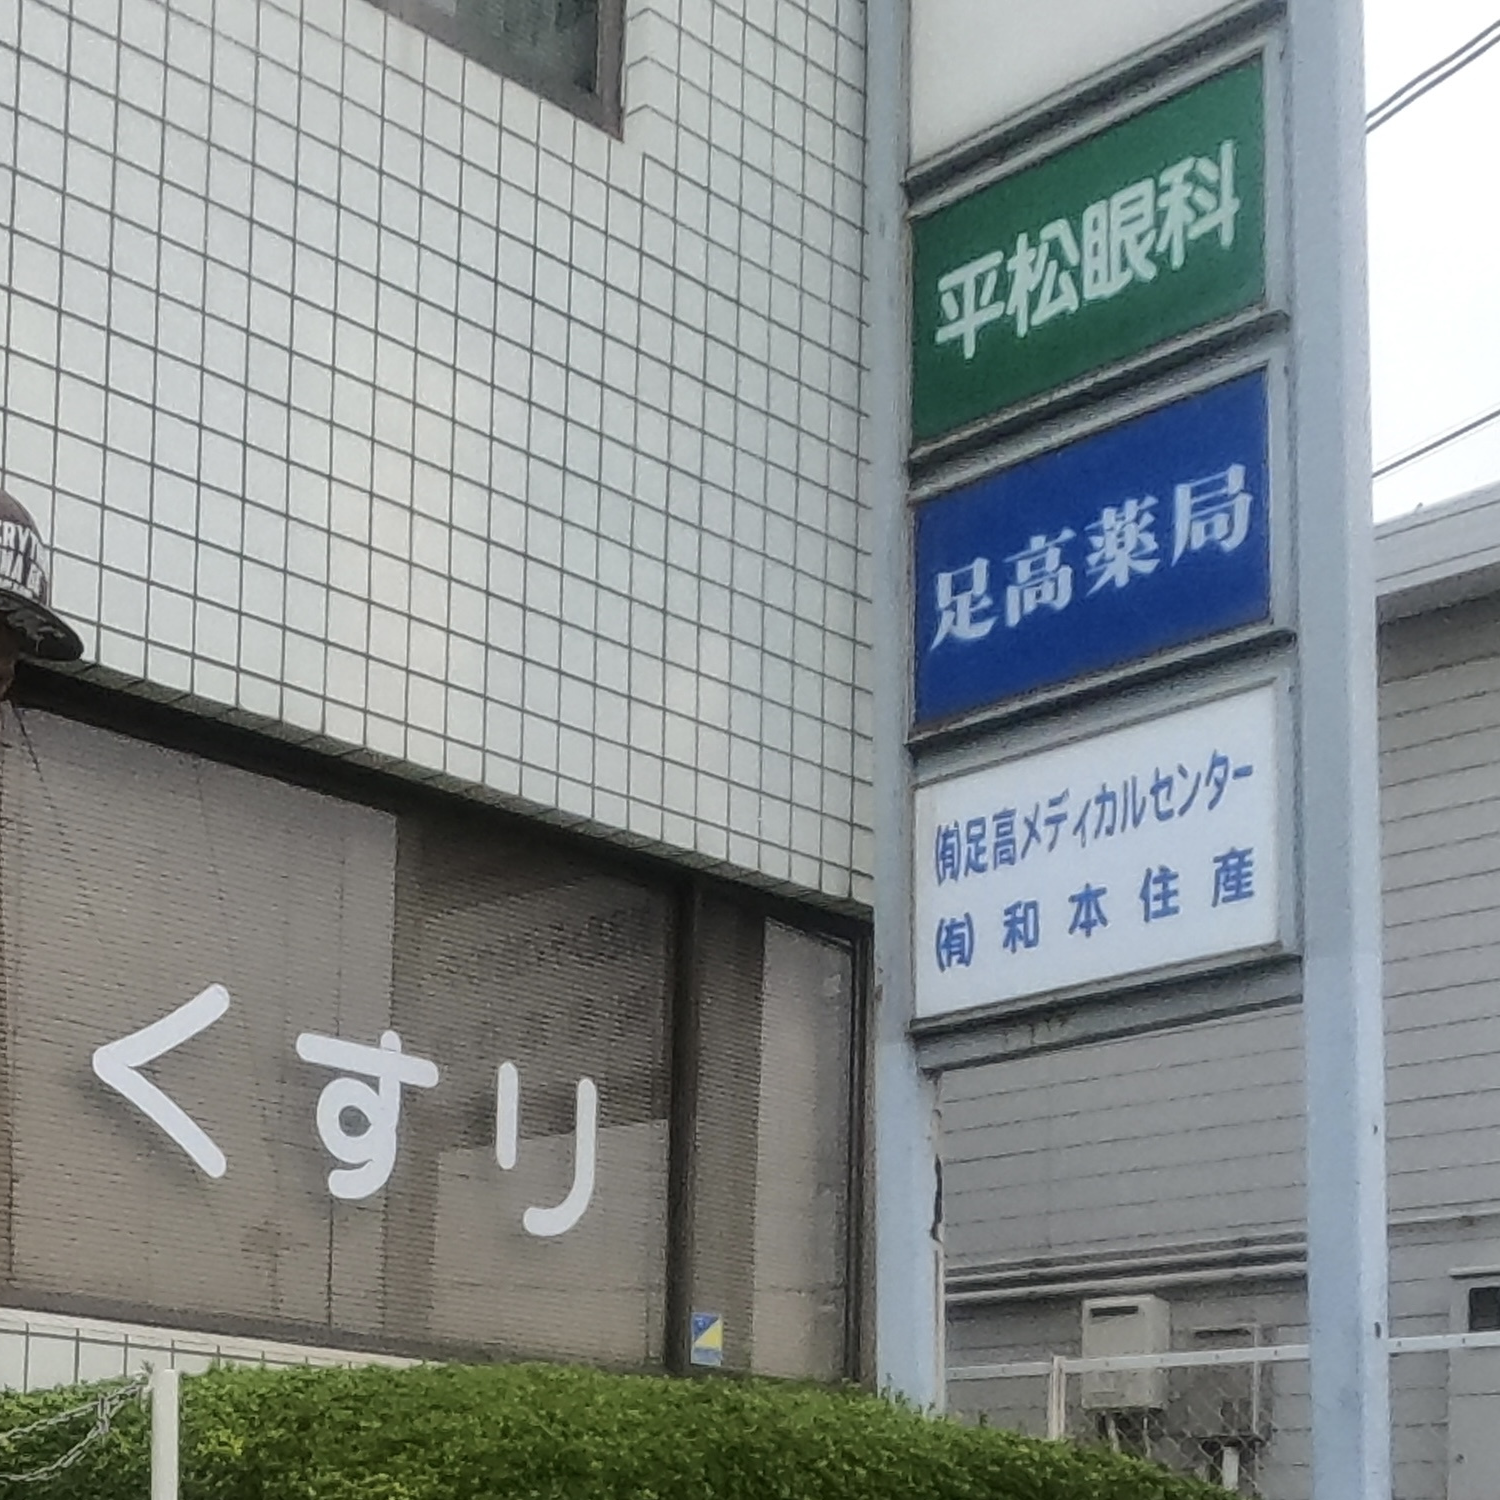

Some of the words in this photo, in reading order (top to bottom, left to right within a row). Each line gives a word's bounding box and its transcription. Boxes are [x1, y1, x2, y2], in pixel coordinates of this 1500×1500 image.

[934, 139, 1242, 360] 平松眼科
[930, 463, 1255, 651] 足高薬局
[92, 982, 597, 1236] くすり
